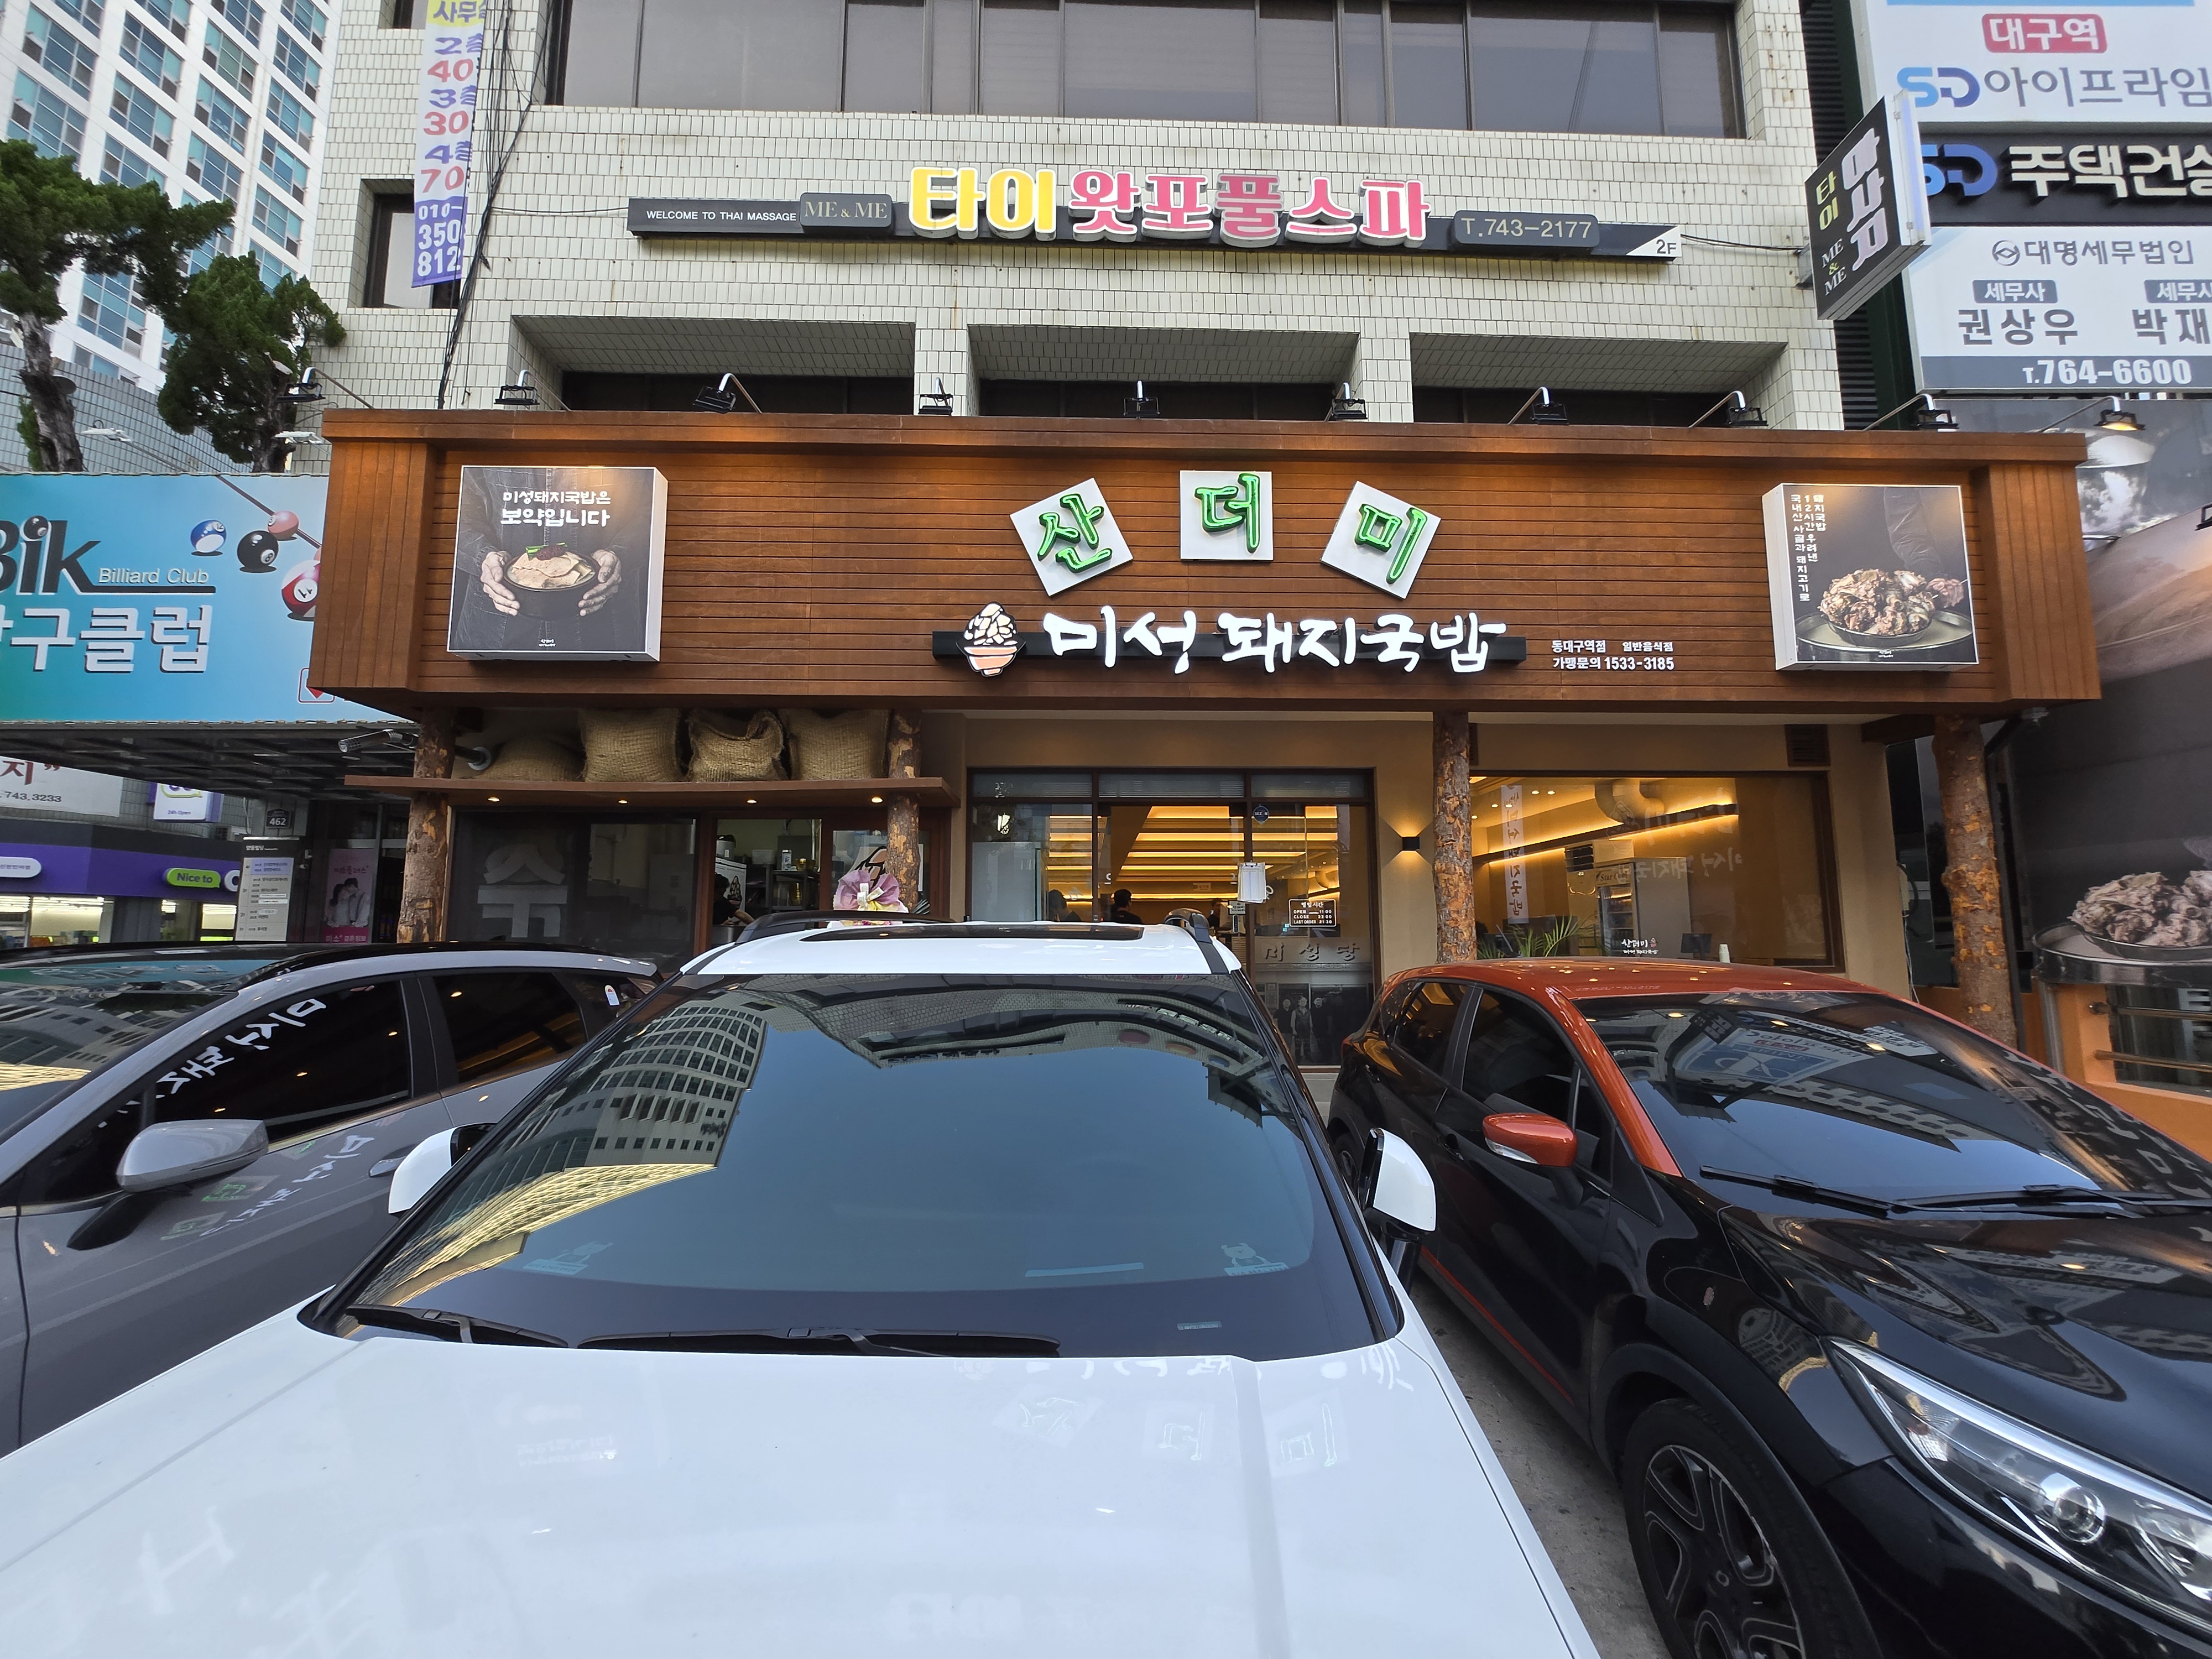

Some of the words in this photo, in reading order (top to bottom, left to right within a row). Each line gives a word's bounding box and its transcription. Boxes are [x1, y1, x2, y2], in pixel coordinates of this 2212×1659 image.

[1989, 17, 2099, 50] 대구역
[1984, 66, 2212, 107] 아이프라임
[805, 201, 837, 217] ME
[841, 208, 851, 218] &
[854, 202, 888, 218] ME
[1816, 171, 1839, 230] 타이
[1841, 128, 1888, 272] 마사지
[646, 211, 698, 220] WELCOME
[702, 211, 716, 220] TO
[719, 212, 743, 221] THAI
[747, 212, 796, 222] MASSAGE
[1461, 217, 1592, 239] T.743-2177
[1656, 239, 1677, 254] 2F
[1822, 238, 1844, 268] ME
[2025, 240, 2193, 265] 대명세무법인
[1829, 262, 1839, 275] &
[1824, 267, 1846, 296] ME
[1985, 281, 2045, 302] 세무사
[2022, 359, 2192, 385] T.764-6600
[500, 509, 611, 526] 보약입니다
[1813, 494, 1827, 531] 돼지국밥
[98, 568, 160, 584] Billiard
[167, 568, 210, 584] Club
[1218, 612, 1507, 673] 돼지국밥
[1551, 640, 1606, 653] 동대구역점
[1622, 641, 1673, 652] 일반음식점
[1553, 656, 1601, 670] 가맹문의
[1604, 657, 1674, 670] 1533-3185
[177, 873, 200, 882] Nice
[202, 874, 212, 883] to
